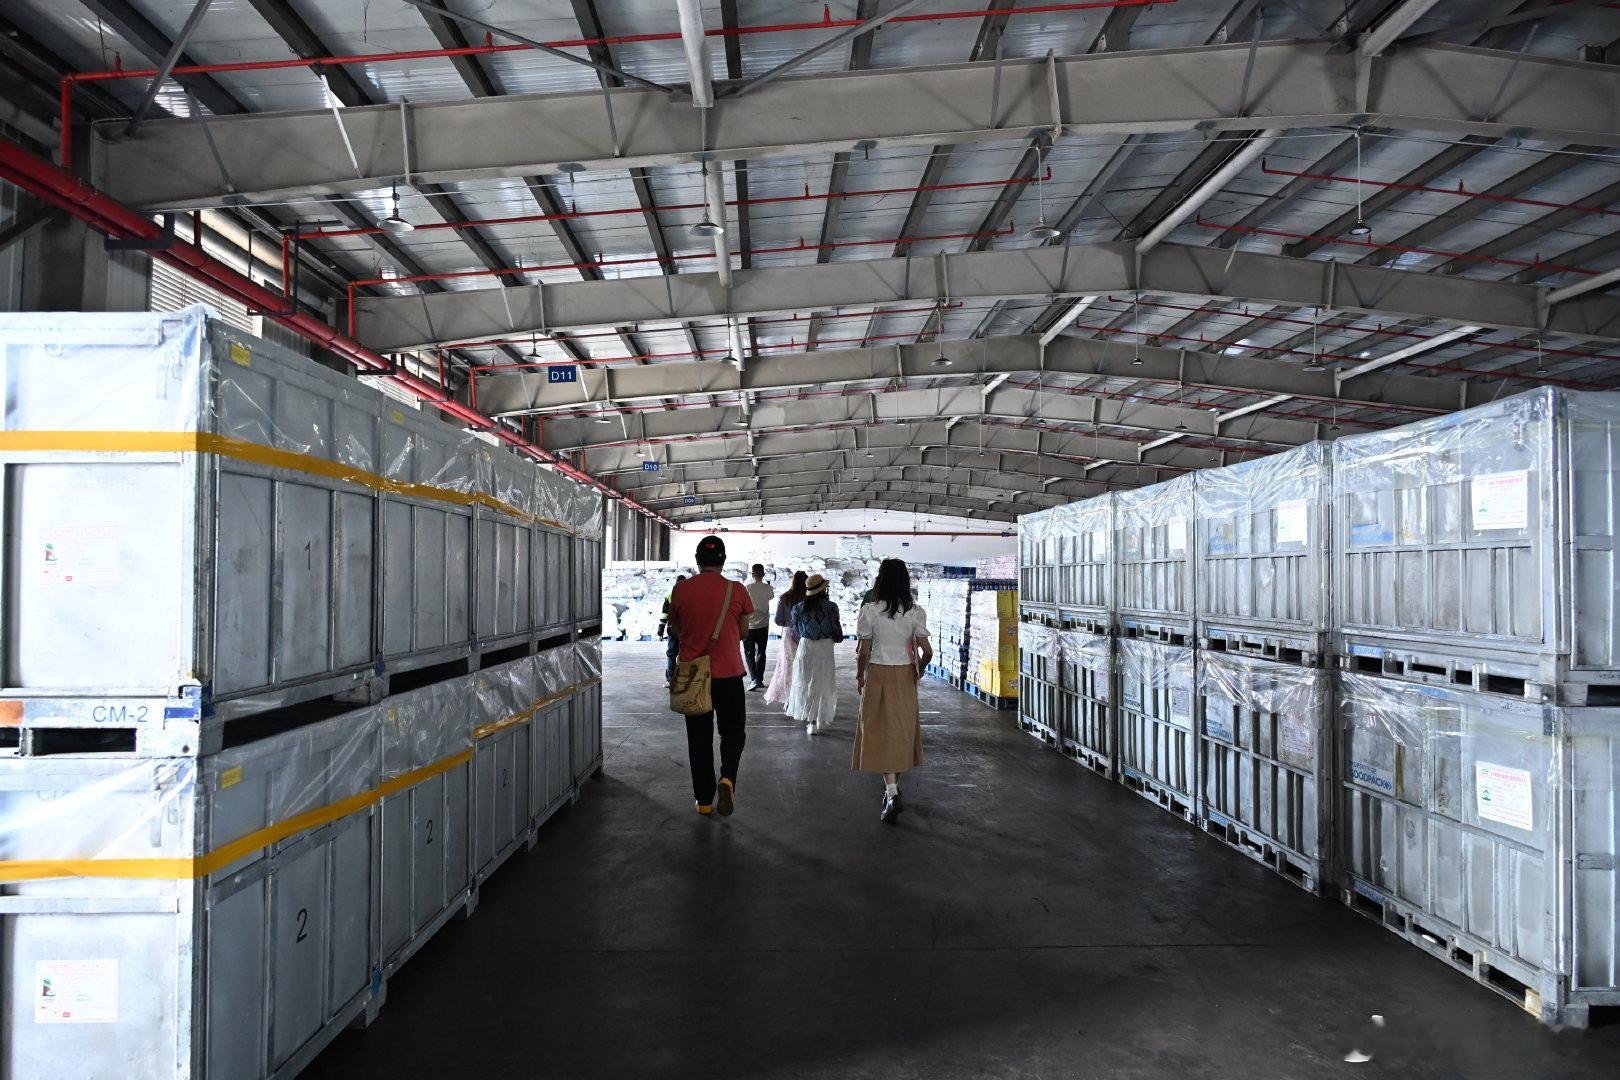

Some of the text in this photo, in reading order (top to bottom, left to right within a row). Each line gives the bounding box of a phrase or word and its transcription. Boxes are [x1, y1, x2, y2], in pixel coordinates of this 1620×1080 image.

[551, 371, 572, 381] D11
[644, 463, 658, 471] D10
[304, 540, 311, 571] 1
[92, 705, 149, 723] CM-2
[426, 819, 433, 845] 2
[296, 908, 307, 943] 2
